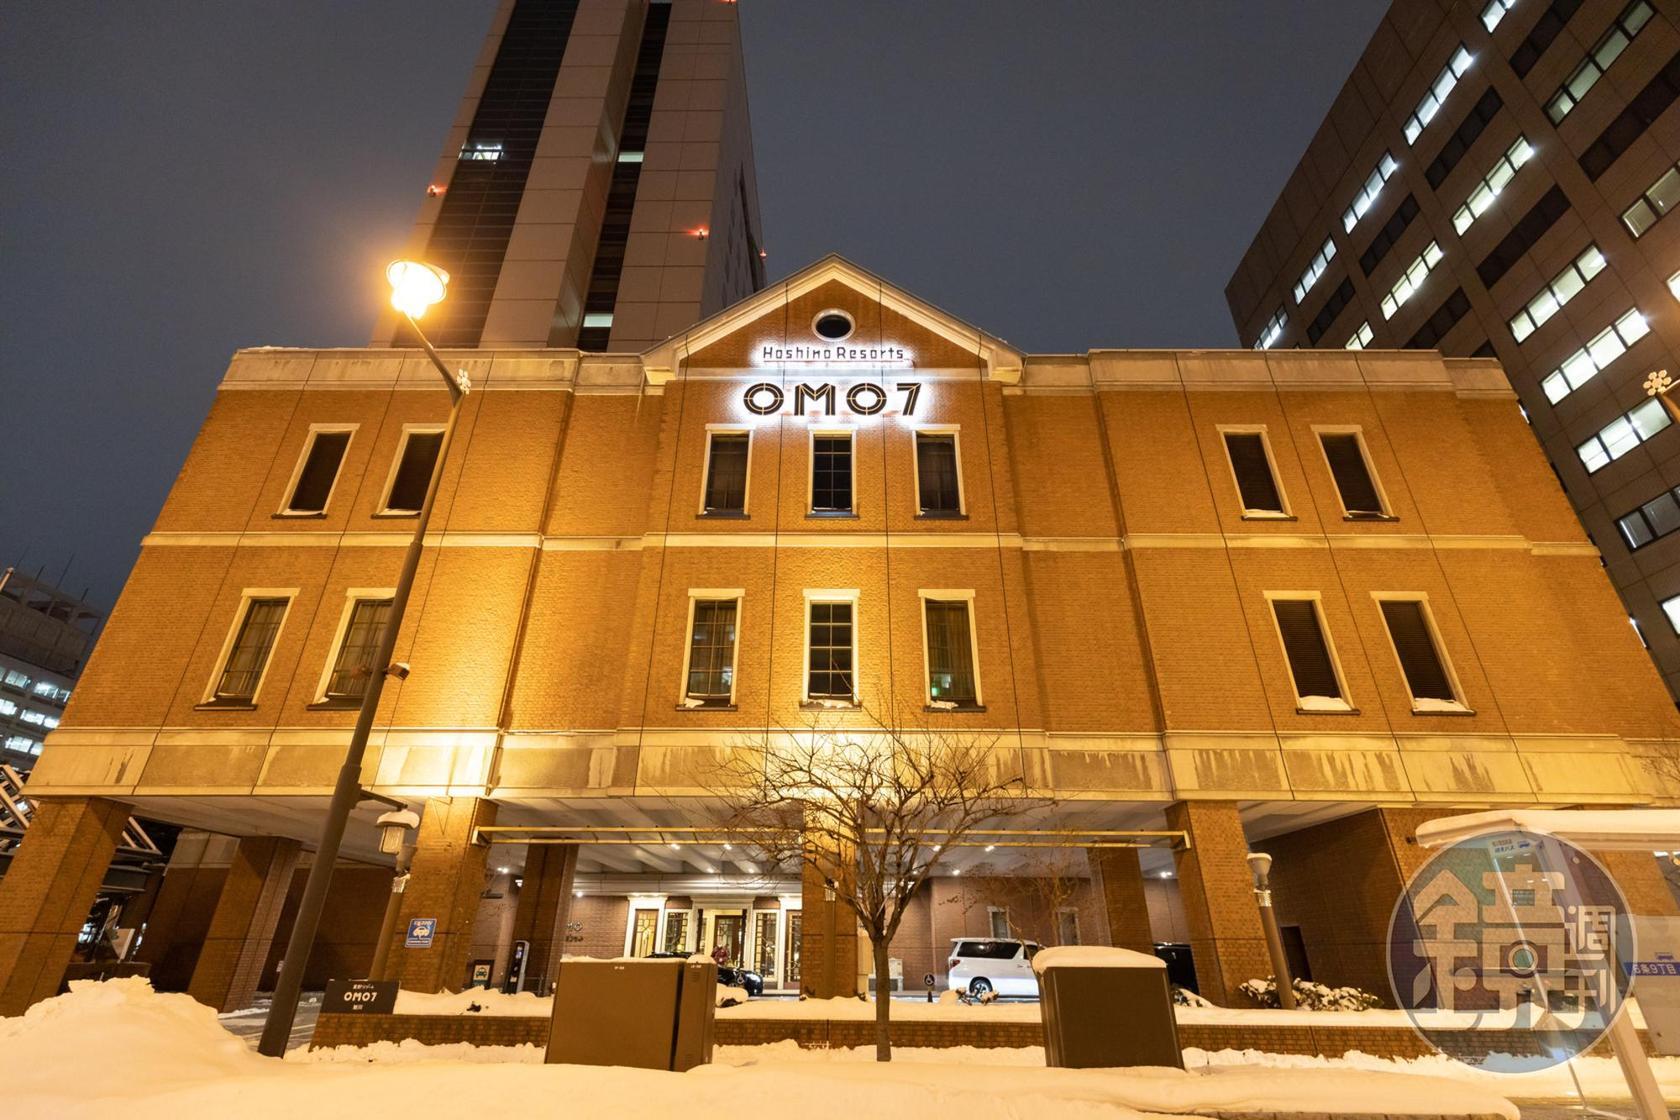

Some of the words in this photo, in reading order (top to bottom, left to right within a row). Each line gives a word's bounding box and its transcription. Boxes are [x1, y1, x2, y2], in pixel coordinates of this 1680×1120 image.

[763, 346, 831, 359] Hoshino
[837, 346, 904, 359] Resorts
[743, 382, 922, 416] OMO7
[343, 991, 378, 1002] OMO7
